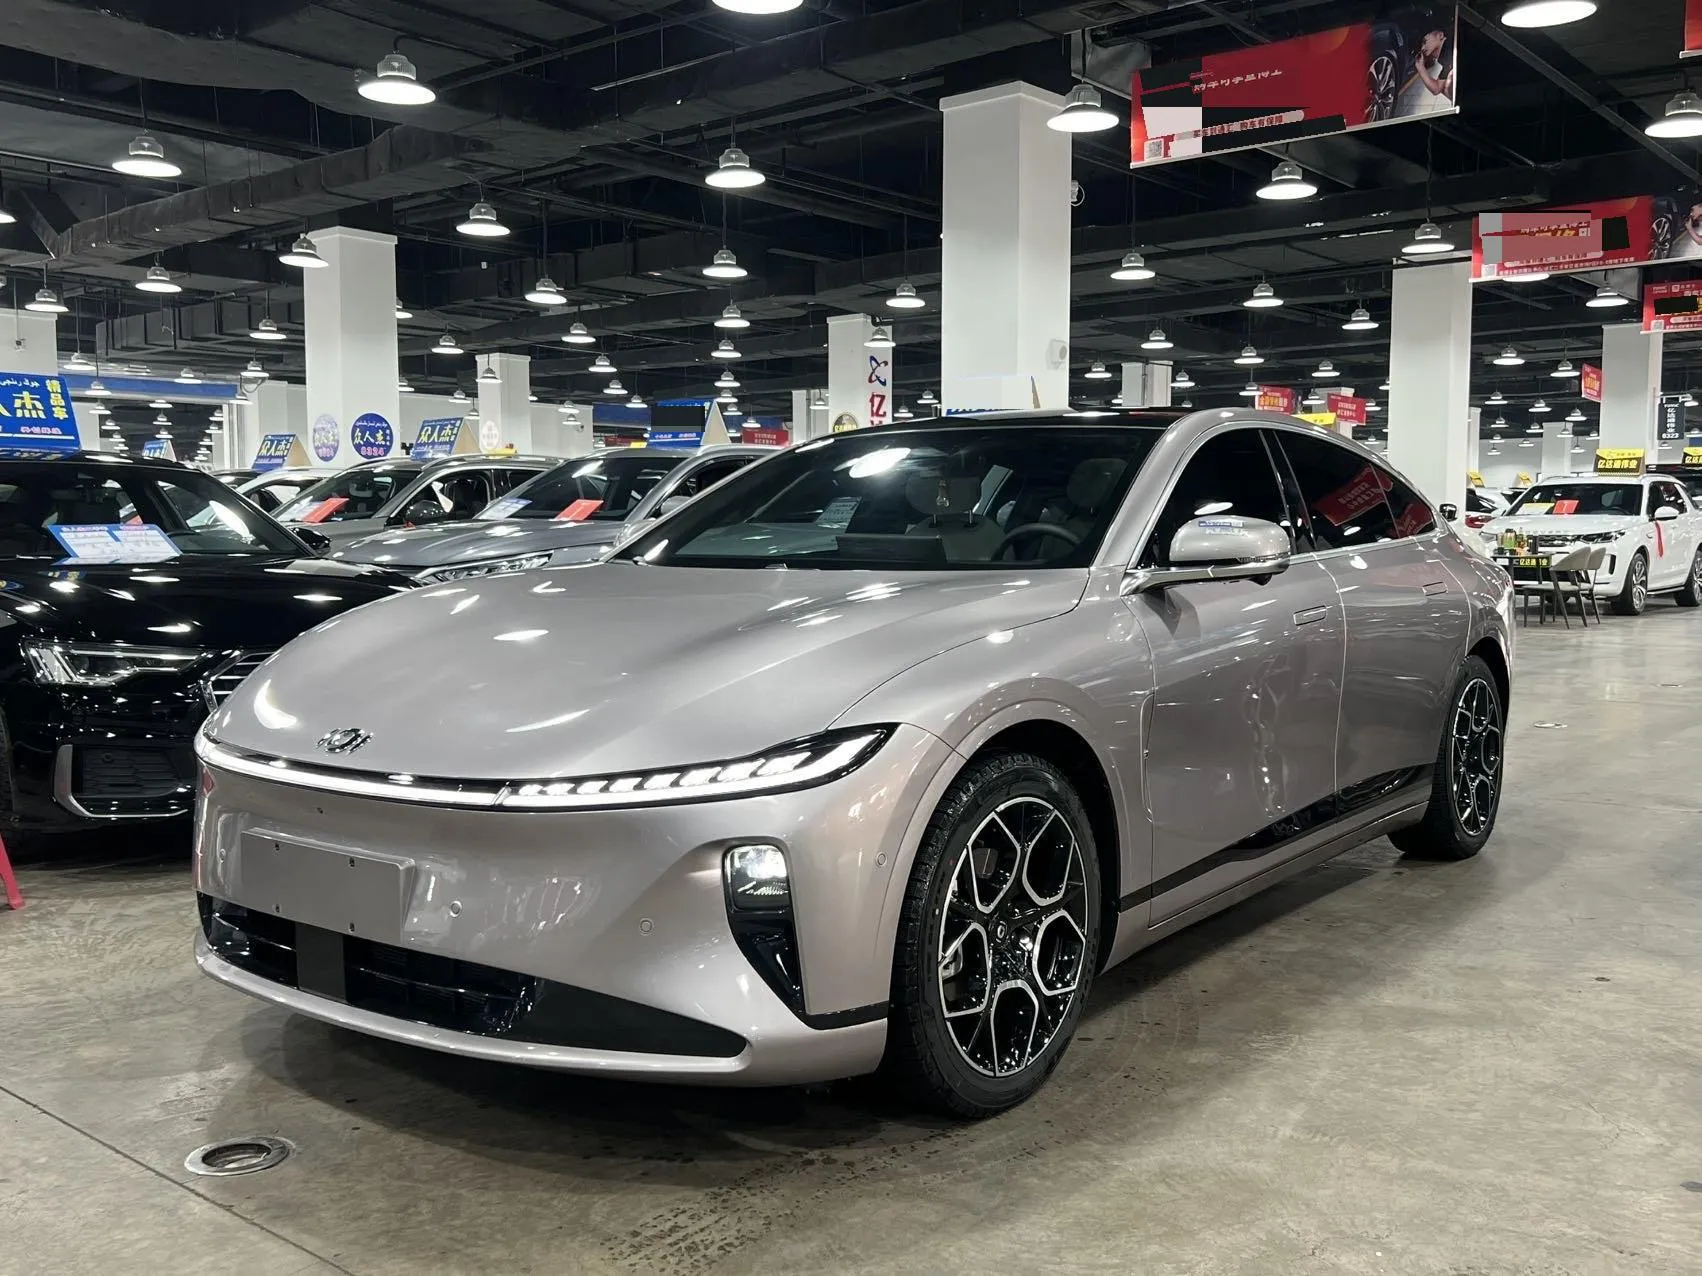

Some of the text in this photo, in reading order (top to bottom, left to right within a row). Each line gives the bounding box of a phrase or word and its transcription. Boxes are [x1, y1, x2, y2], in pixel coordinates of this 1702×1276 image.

[1597, 459, 1638, 469] 亿达通伟业
